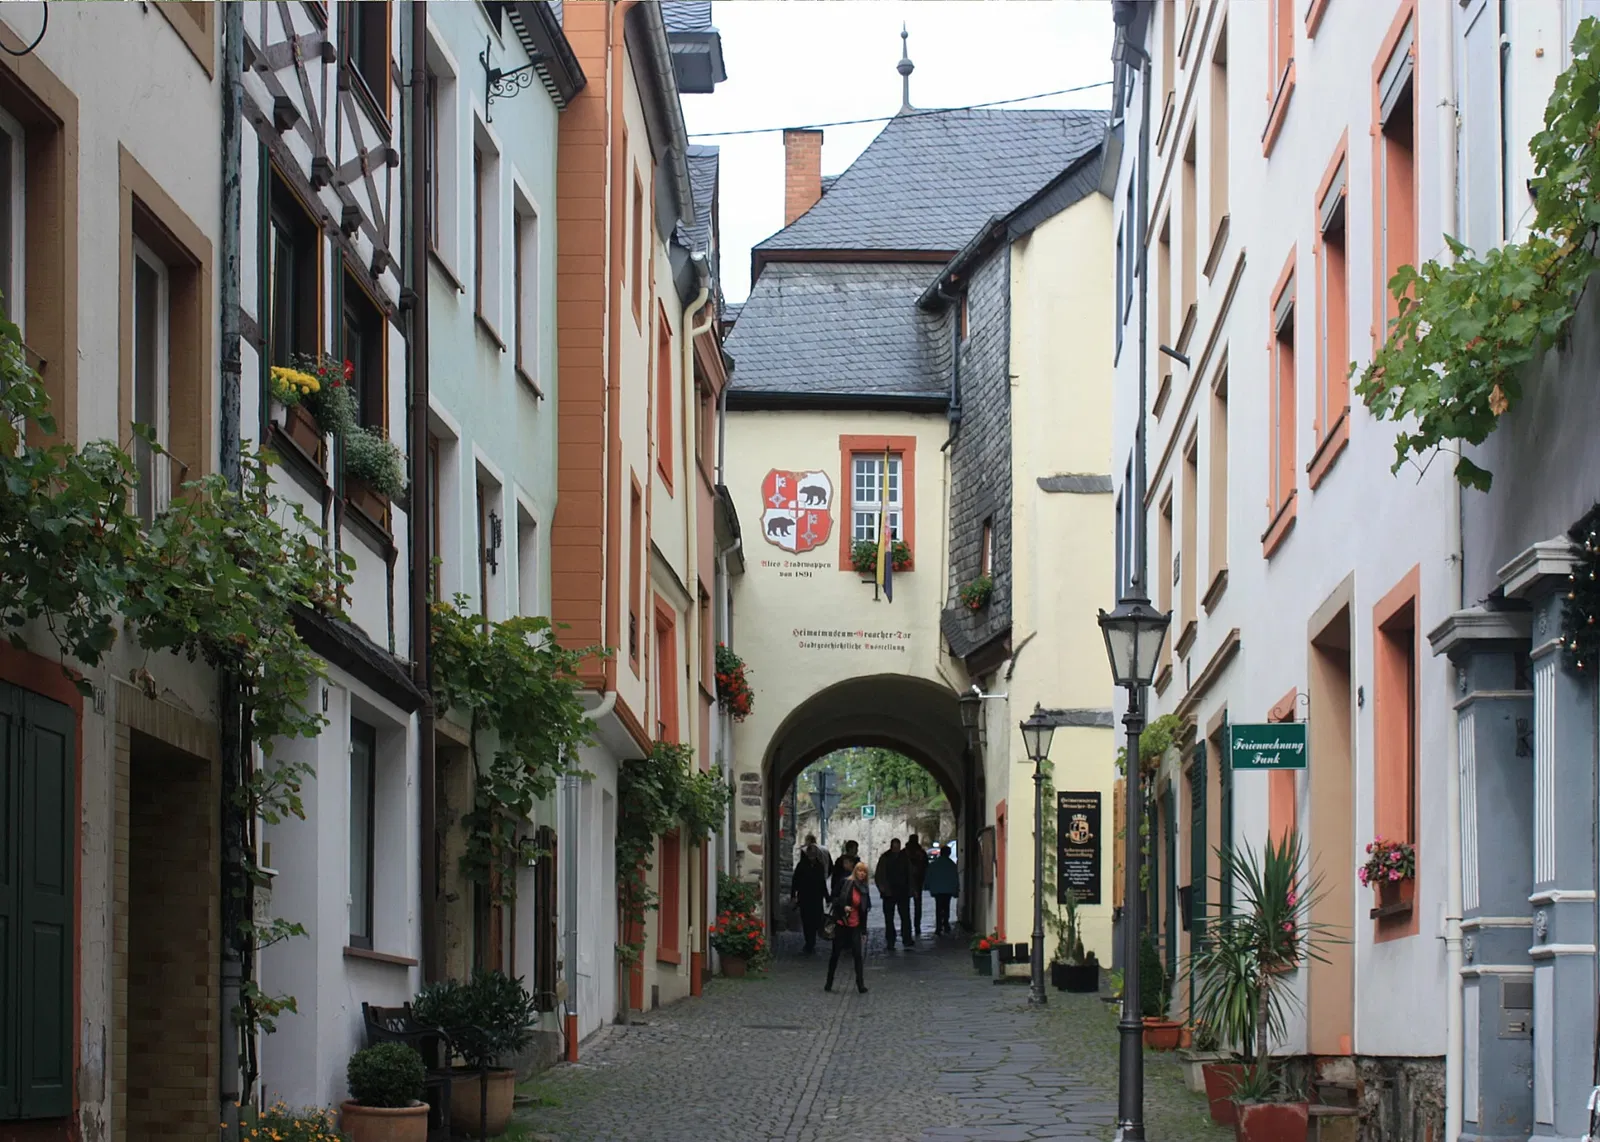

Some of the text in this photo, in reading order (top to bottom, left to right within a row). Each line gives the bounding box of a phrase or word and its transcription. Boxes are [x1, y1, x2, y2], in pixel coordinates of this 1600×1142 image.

[761, 560, 831, 569] Altes Stadtwappen
[865, 643, 905, 652] Ausstellung
[1233, 738, 1304, 754] Ferienwohnung
[1252, 752, 1280, 764] Funk
